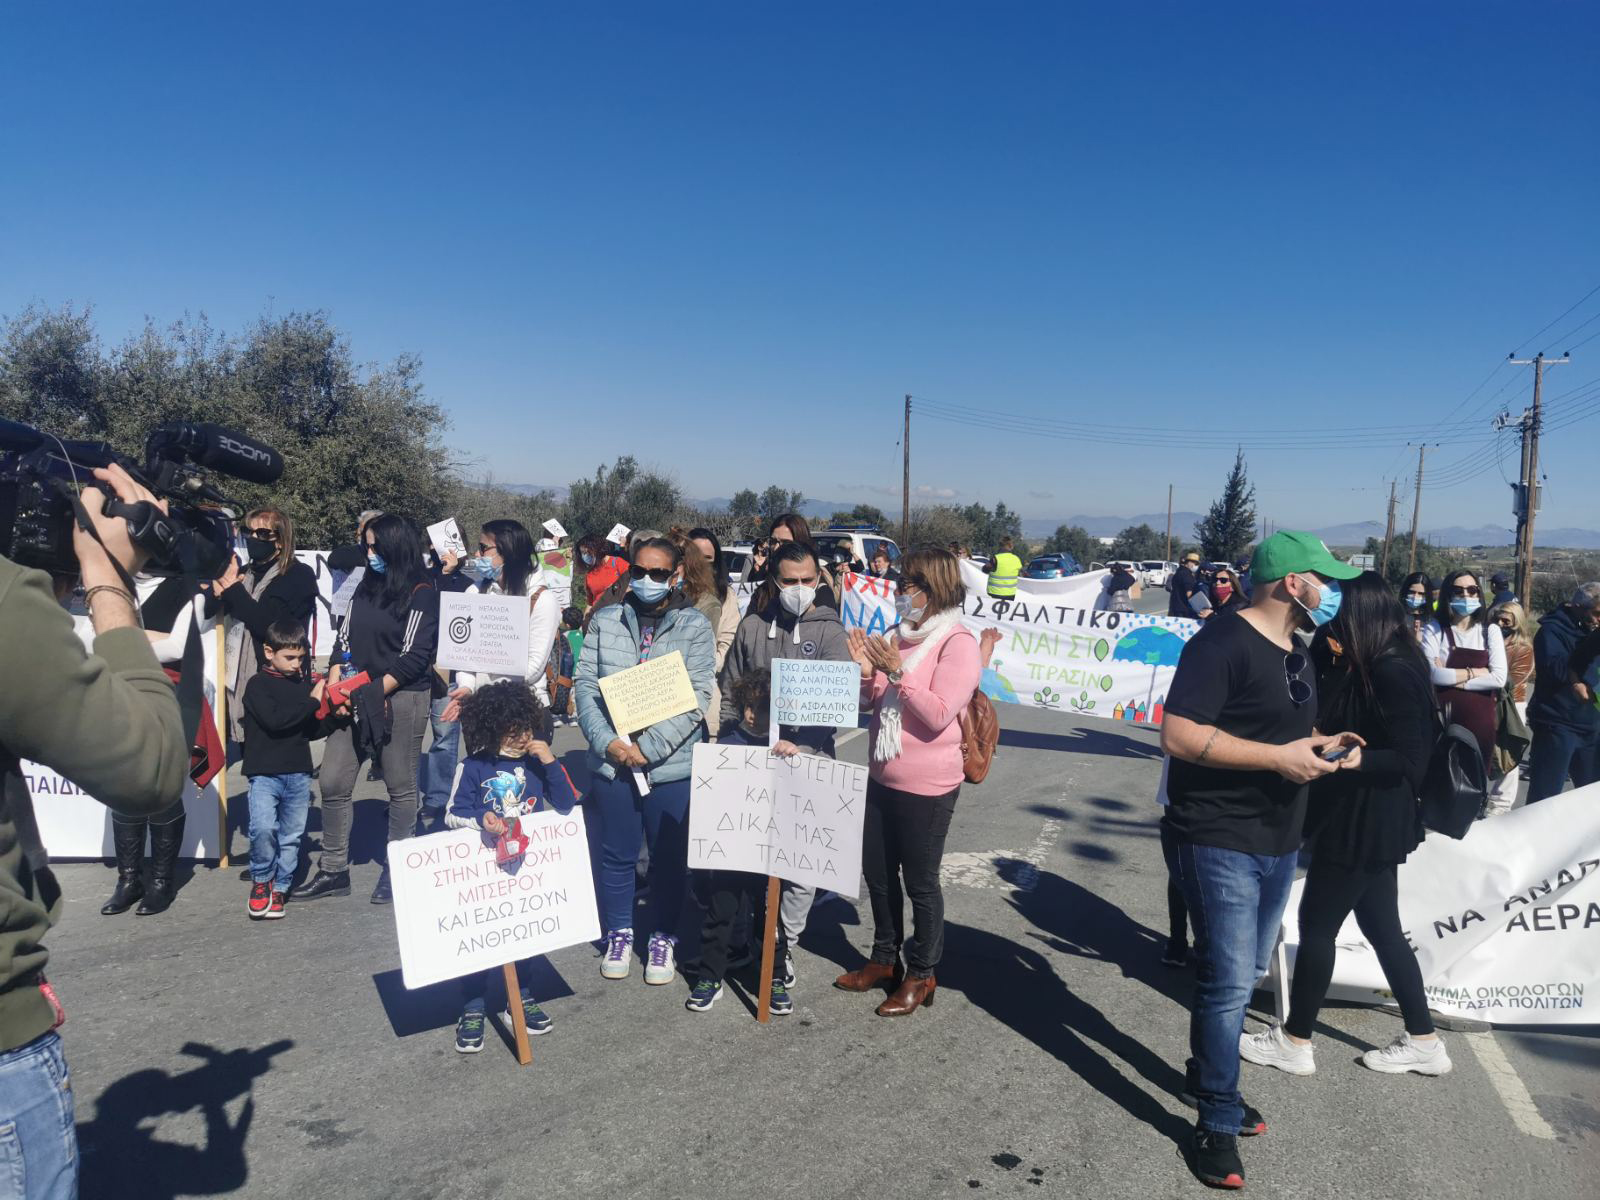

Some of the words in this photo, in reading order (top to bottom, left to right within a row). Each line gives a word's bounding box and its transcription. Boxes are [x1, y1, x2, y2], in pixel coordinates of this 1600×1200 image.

[1011, 629, 1058, 655] ΝΑΙ
[780, 663, 800, 672] ΕΧΩ
[803, 664, 852, 674] ΔΙΚΑΙΩΜΑ
[782, 675, 796, 683] ΝΑ
[800, 676, 848, 685] ΑΝΑΠΝΕΩ
[775, 697, 798, 710] ΟΧΙ
[800, 702, 856, 712] ΑΣΦΑΛΤΙΚΟ
[780, 687, 822, 696] ΚΑΘΑΡΟ
[825, 688, 851, 697] ΑΕΡΑ
[778, 711, 797, 721] ΣΤΟ
[801, 713, 844, 723] ΜΙΤΣΕΡΟ
[716, 747, 867, 792] ΣΚΕΦΤΕΙΤΕ
[25, 775, 89, 795] ΠΑΙΔΙ
[745, 785, 776, 805] ΚΑΙ
[790, 793, 816, 817] ΤΑ
[716, 812, 780, 836] ΔΙΚΑ
[794, 823, 839, 851] ΜΑΣ
[406, 848, 440, 869] ΟΧΙ
[448, 842, 471, 861] ΤΟ
[478, 821, 578, 855] ΑΛΤΙΚΟ
[692, 838, 726, 860] ΤΑ
[755, 844, 837, 876] ΠΑΙΔΙΑ
[433, 863, 479, 887] ΣΤΗΝ
[458, 872, 544, 905] ΜΙΤΣΕΡΟΥ
[438, 911, 469, 933] ΚΑΙ
[474, 901, 514, 924] ΕΔΩ
[519, 888, 567, 914] ΖΟΥΝ
[457, 916, 561, 956] ΑΝΘΡΩΠΟΙ
[1433, 909, 1486, 939] ΝΑ
[1424, 985, 1471, 1000] ΝΗΜΑ
[1476, 983, 1584, 999] ΟΙΚΟΛΟΓΩΝ
[1509, 997, 1583, 1009] ΠΟΛΙΤΩΝ
